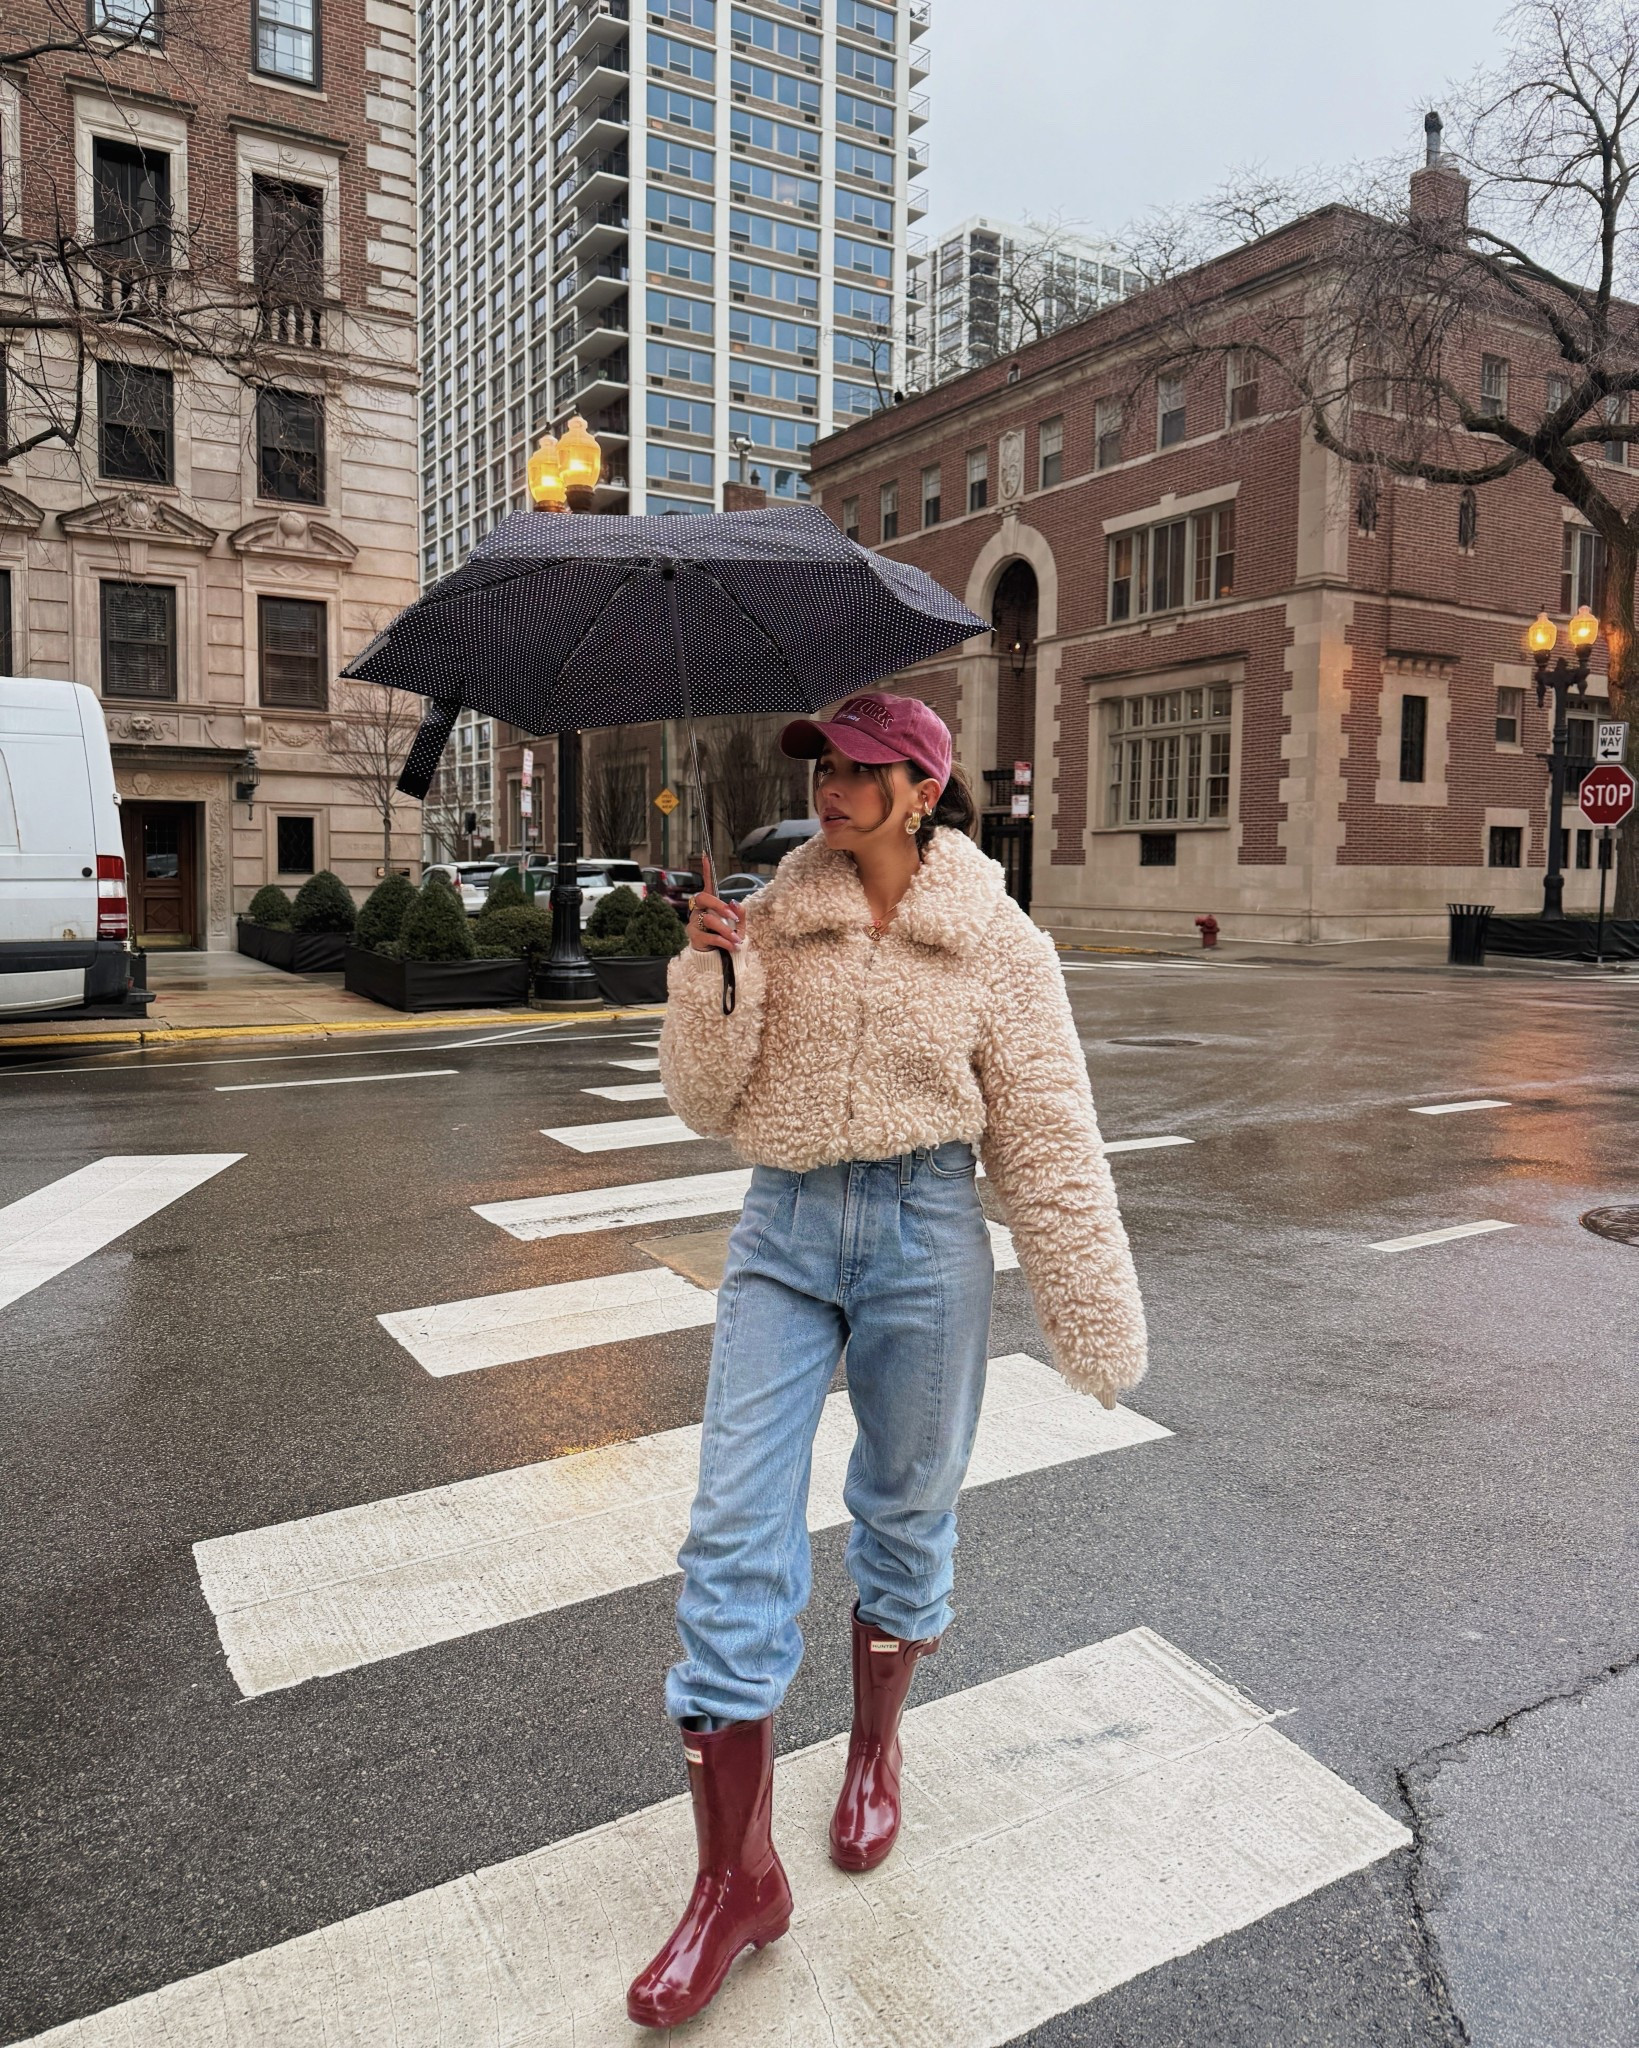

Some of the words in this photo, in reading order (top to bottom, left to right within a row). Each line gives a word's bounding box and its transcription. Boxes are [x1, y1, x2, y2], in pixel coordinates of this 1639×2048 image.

[1601, 726, 1622, 736] ONE
[1600, 737, 1621, 747] WAY
[1583, 784, 1631, 807] STOP
